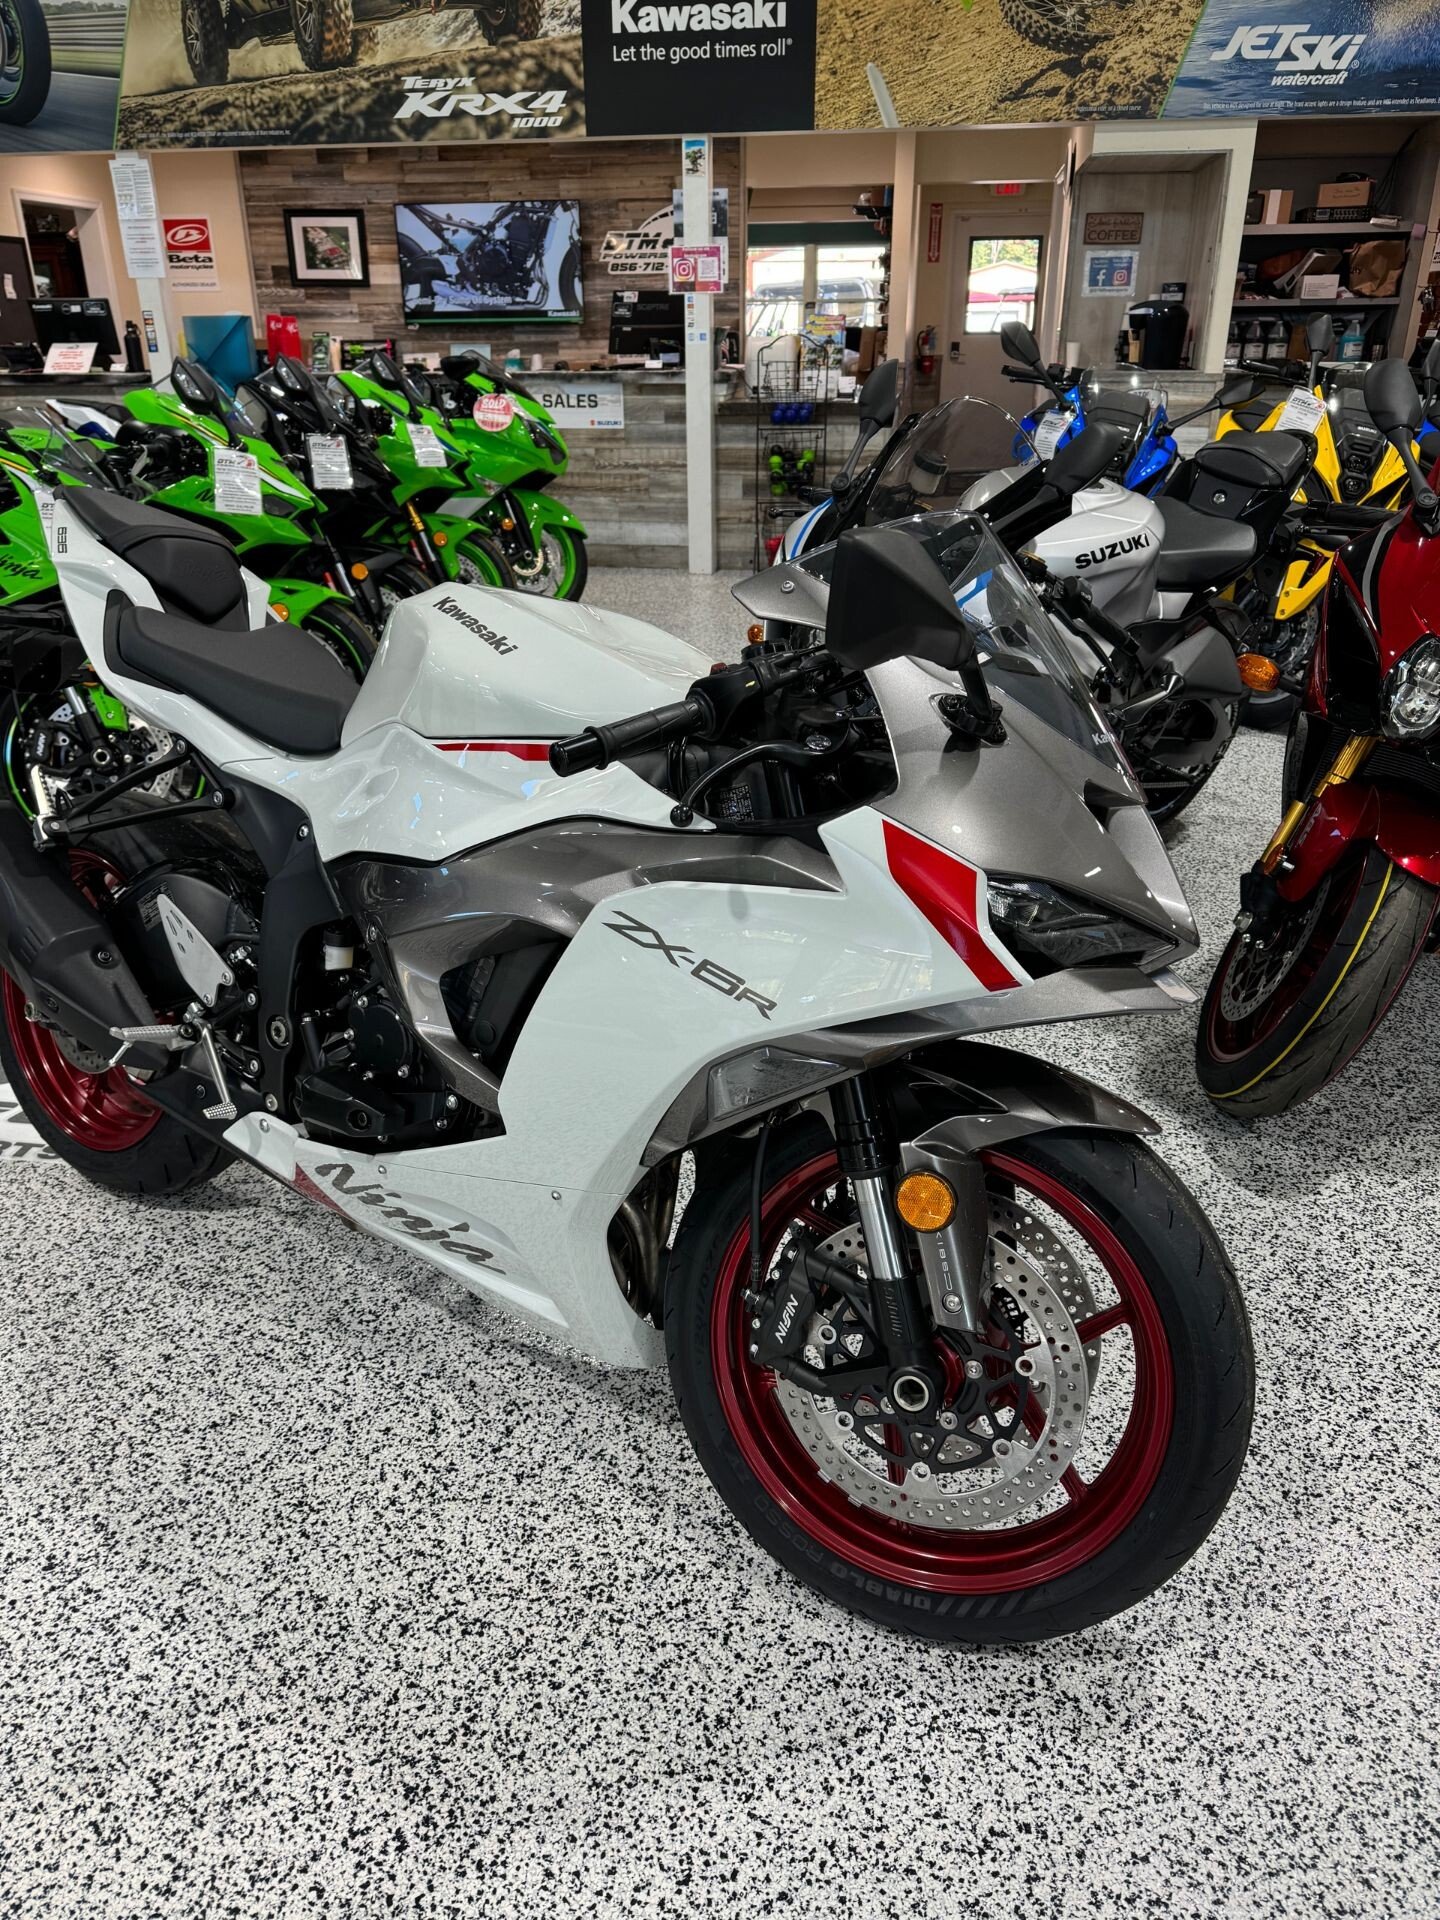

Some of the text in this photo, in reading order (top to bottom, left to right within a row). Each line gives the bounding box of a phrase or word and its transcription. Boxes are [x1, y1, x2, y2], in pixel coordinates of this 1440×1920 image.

[611, 0, 787, 34] Kawasaki
[612, 45, 637, 62] Let
[640, 43, 666, 61] the
[670, 41, 711, 64] good
[714, 41, 757, 58] times
[1270, 71, 1349, 86] watercraft
[511, 116, 564, 129] 1000
[1087, 230, 1138, 241] COFFEE
[168, 253, 214, 263] Beta
[602, 252, 668, 260] POWERS
[481, 398, 507, 409] SOLD
[542, 393, 598, 409] SALES
[57, 526, 68, 554] 636
[1075, 533, 1150, 570] SUZUKI
[0, 553, 43, 580] inja
[432, 596, 519, 656] Kawasaki
[600, 910, 778, 1021] ZX-6R
[314, 1162, 507, 1276] Ninja
[774, 1293, 800, 1345] NISSIN
[754, 1496, 825, 1564] ROSSO
[830, 1562, 932, 1613] DIABLO
